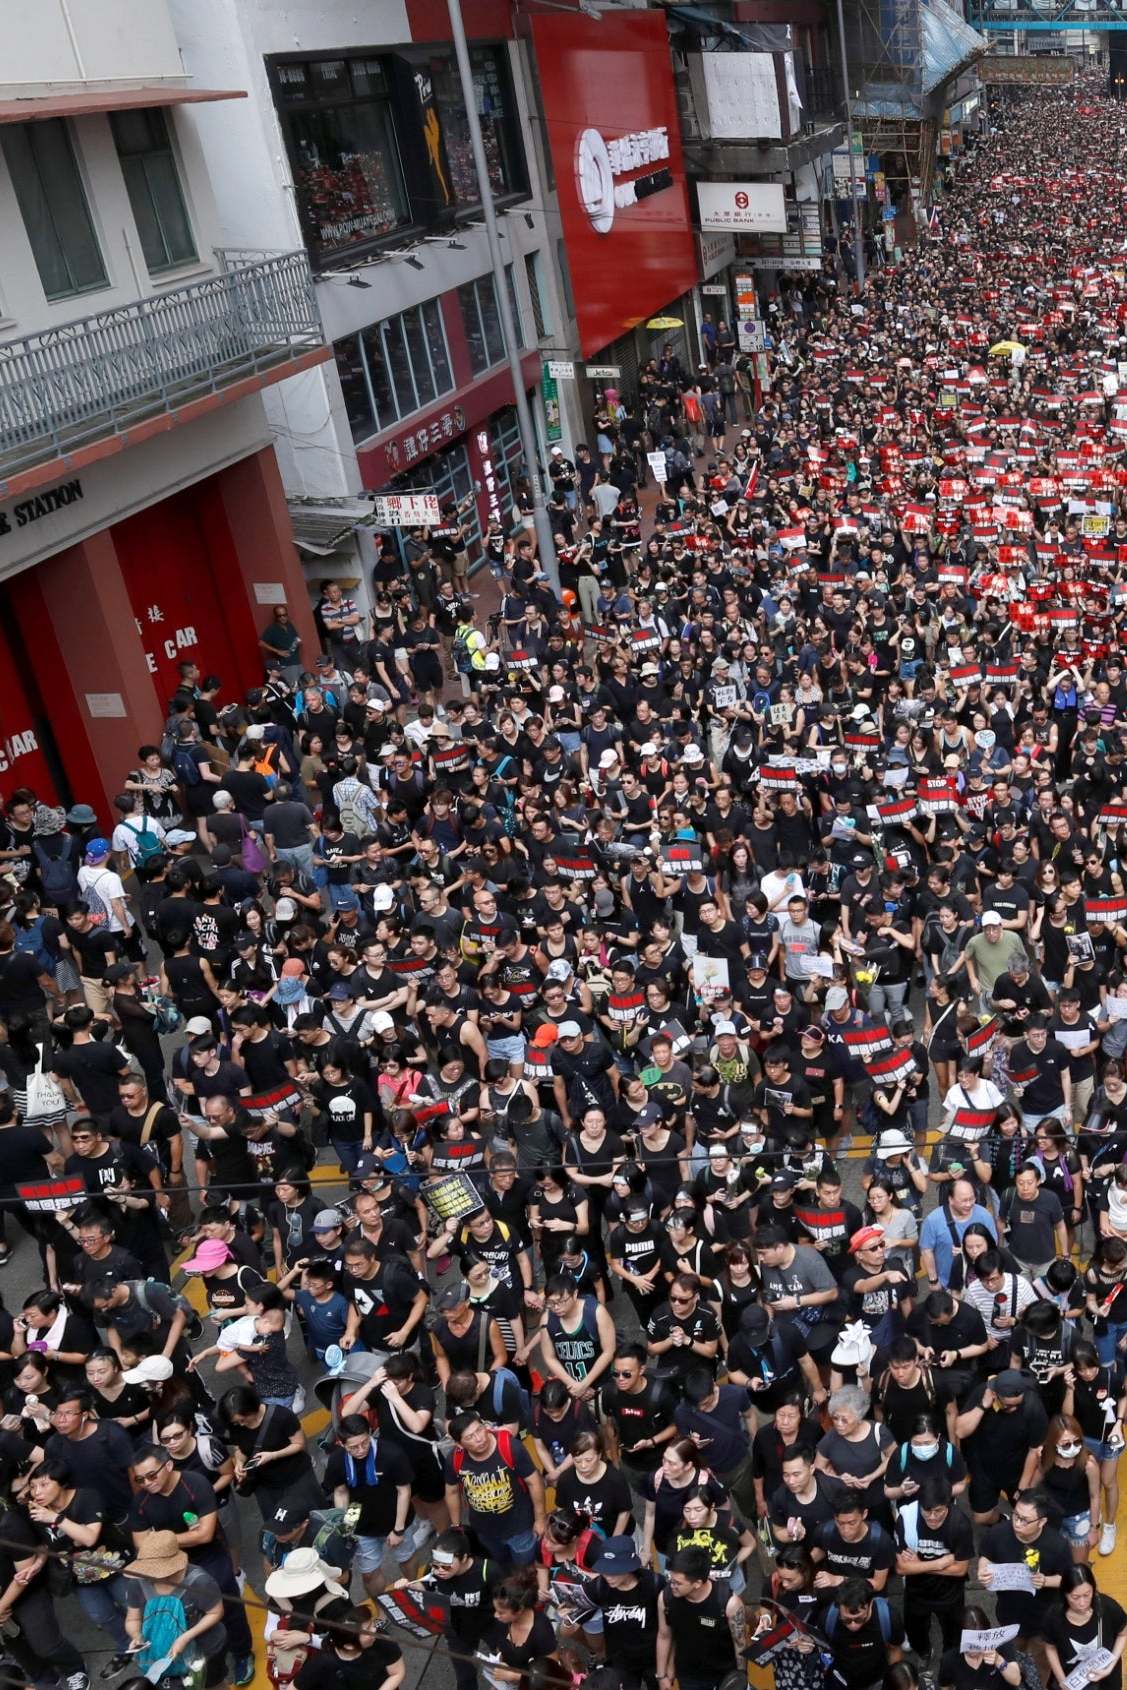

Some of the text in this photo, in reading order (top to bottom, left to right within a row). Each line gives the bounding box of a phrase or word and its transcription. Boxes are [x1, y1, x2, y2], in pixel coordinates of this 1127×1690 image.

[16, 479, 84, 528] STATION
[164, 626, 198, 660] CAR
[927, 779, 947, 788] STOP
[625, 1239, 655, 1253] PUMA
[555, 1340, 595, 1361] CELTICS
[565, 1361, 588, 1383] 11
[274, 1507, 288, 1522] H
